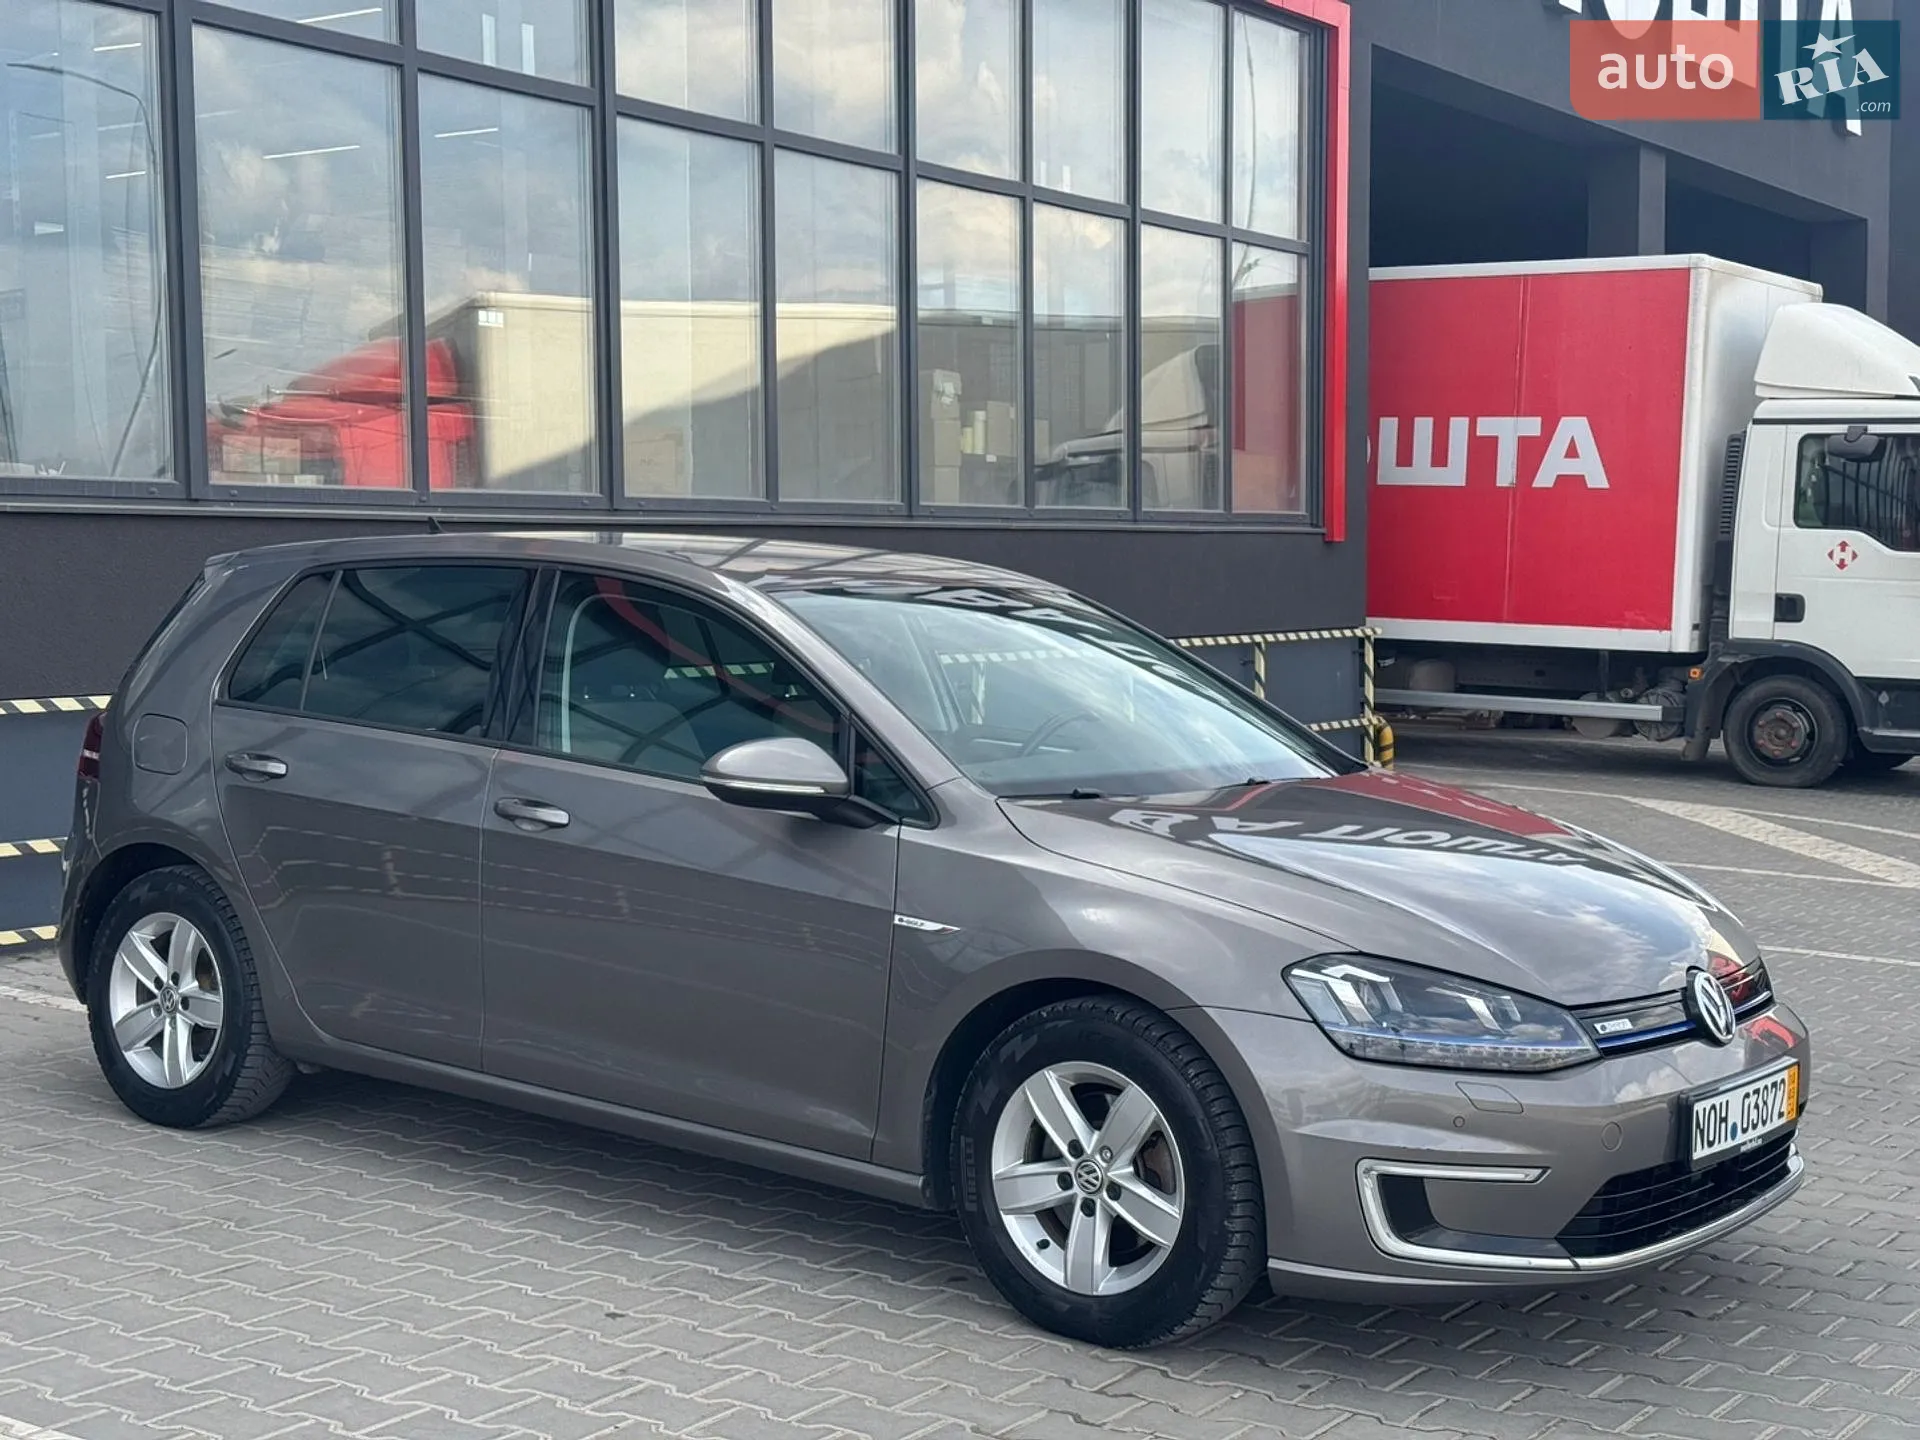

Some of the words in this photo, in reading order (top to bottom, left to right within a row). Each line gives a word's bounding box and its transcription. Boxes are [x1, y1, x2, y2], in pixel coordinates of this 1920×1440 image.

[1366, 416, 1610, 489] ШТА
[1694, 1099, 1729, 1154] NOH
[1741, 1078, 1786, 1135] 03872
